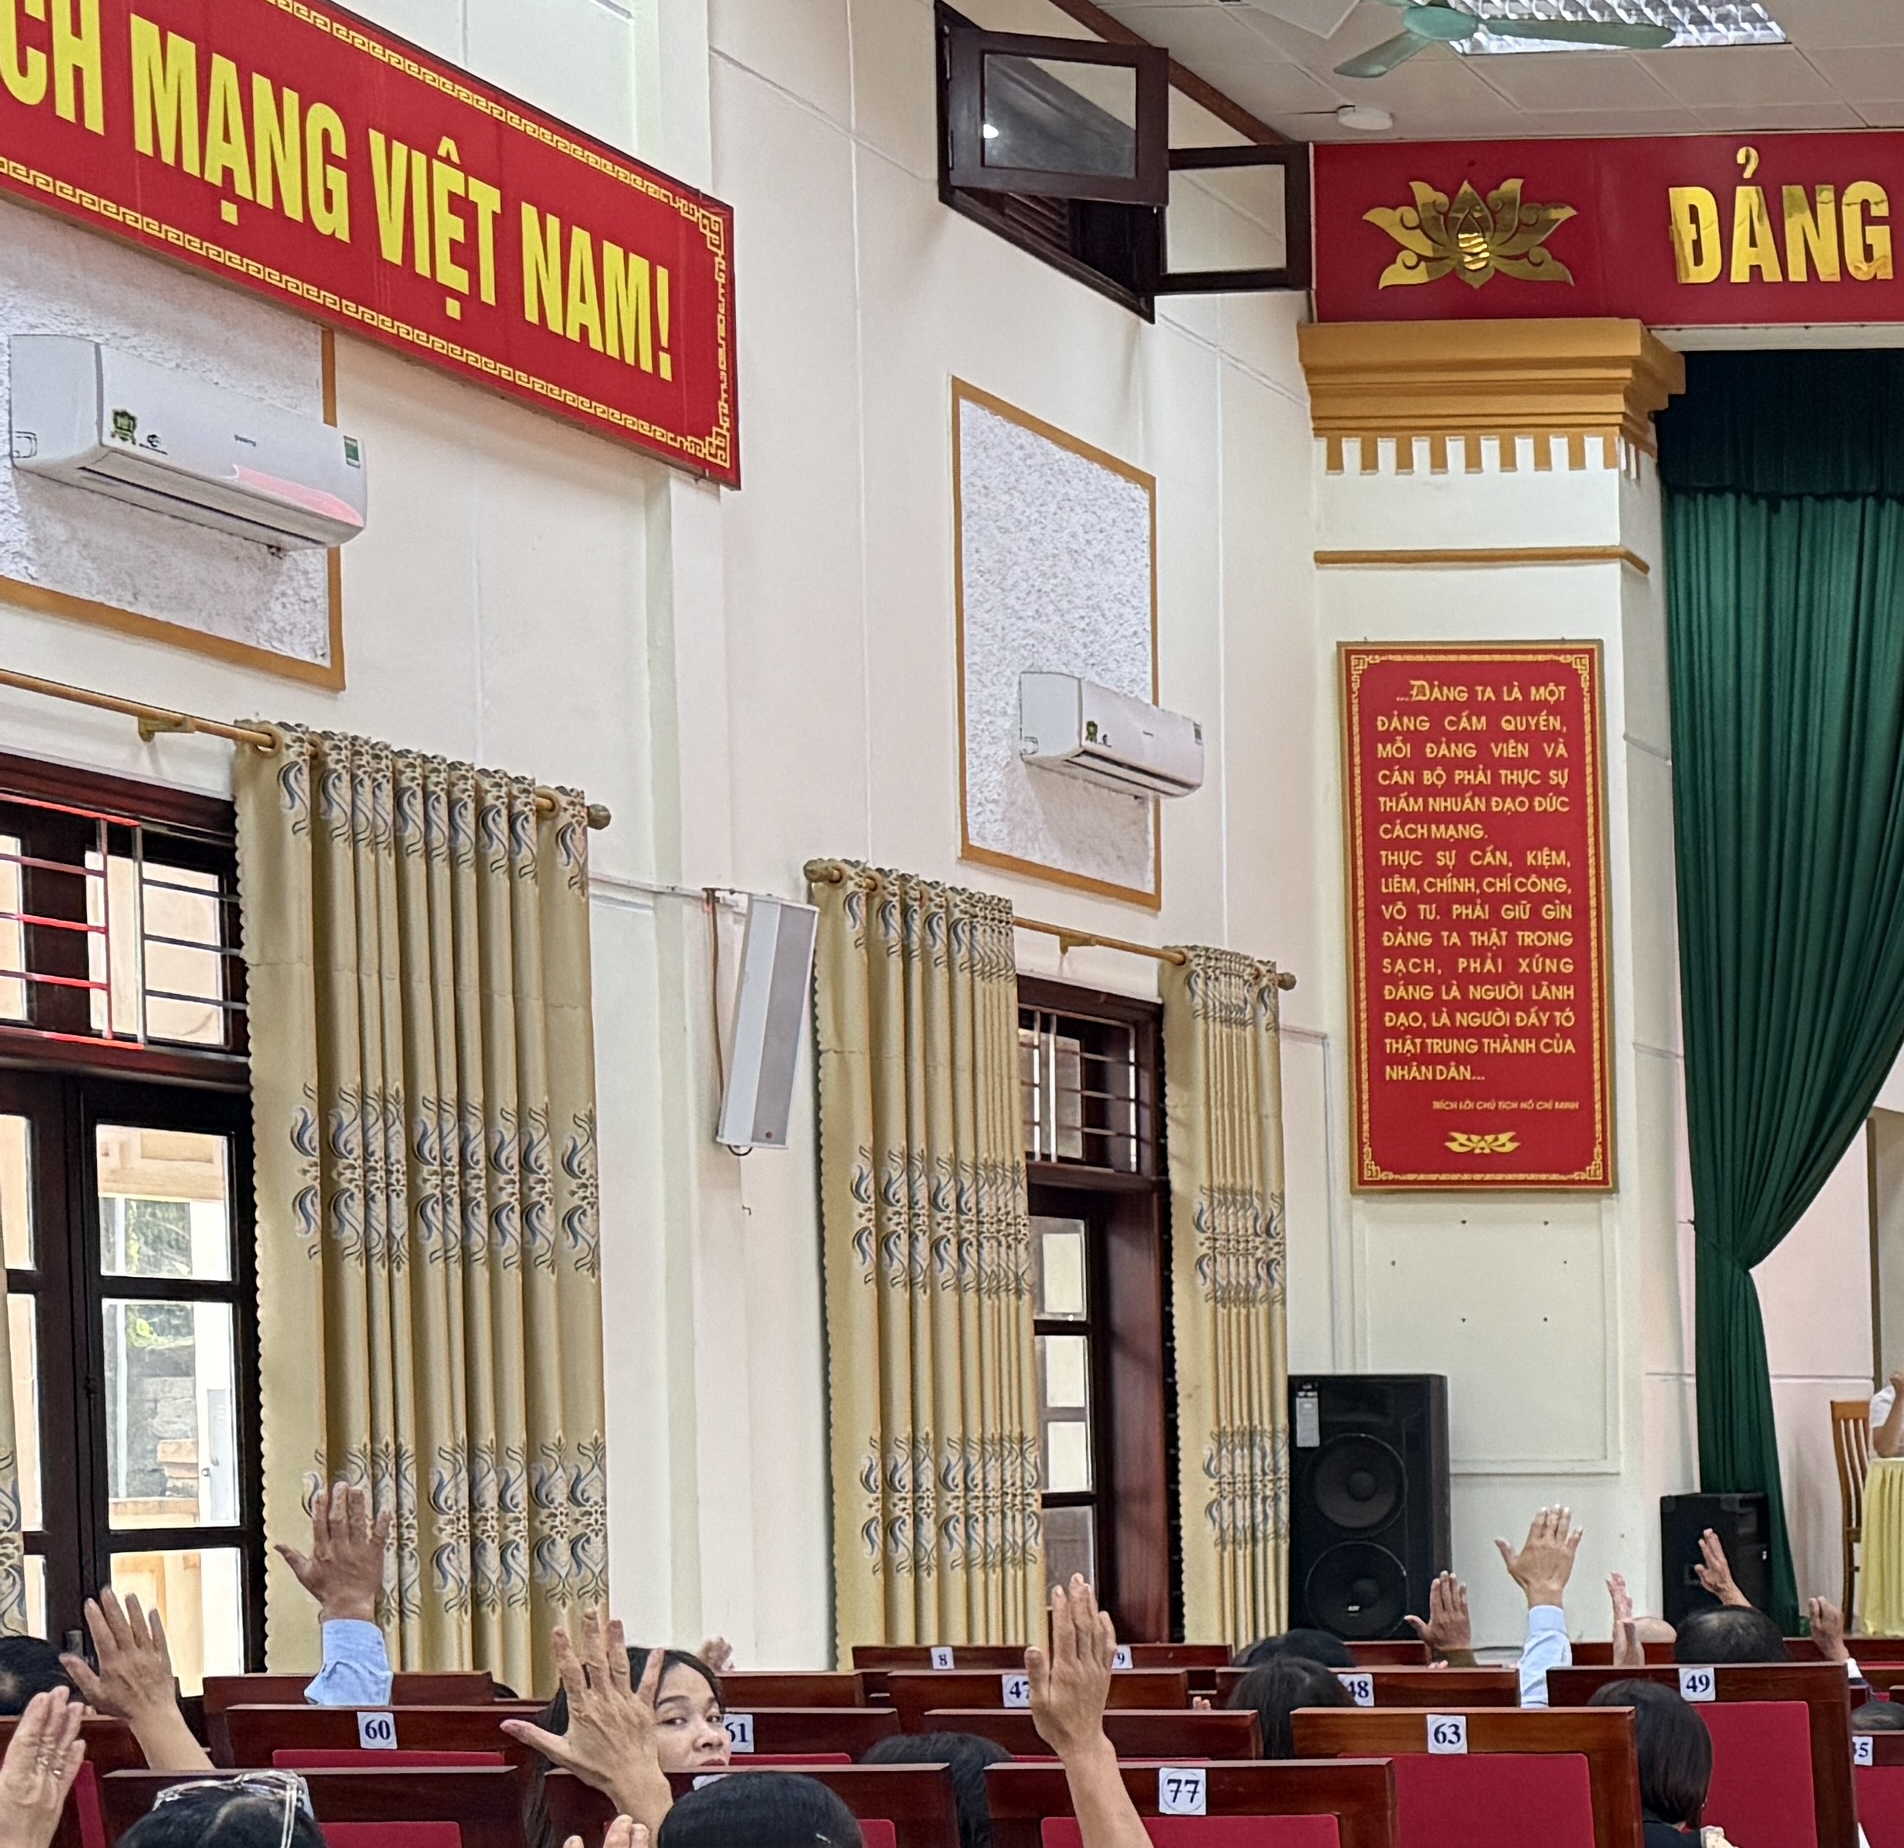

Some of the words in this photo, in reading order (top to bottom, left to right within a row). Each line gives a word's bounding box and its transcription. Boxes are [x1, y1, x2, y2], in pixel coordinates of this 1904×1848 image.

[125, 8, 356, 246] MẠNG
[369, 131, 501, 319] VIỆT
[522, 202, 672, 381] NAM!
[1670, 147, 1892, 283] ĐẢNG
[1474, 686, 1496, 701] TA
[1502, 681, 1523, 701] LÀ
[1530, 682, 1567, 704] MỘT
[1424, 737, 1478, 758] ĐẢNG
[1490, 739, 1529, 757] VIÊN
[1542, 738, 1569, 757] VÀ
[1377, 765, 1415, 785] CÁN
[1422, 766, 1447, 788] BỘ
[1454, 764, 1492, 785] PHẢI
[1498, 768, 1542, 788] THỰC
[1548, 768, 1569, 788] SỰ
[1379, 820, 1428, 839] CÁCH
[1430, 824, 1489, 842] MẠNG.
[1381, 900, 1407, 919] VÔ
[1452, 898, 1489, 919] PHẢI
[1500, 900, 1532, 919] GIỮ
[1541, 899, 1573, 919] GÌN
[1381, 926, 1433, 947] ĐẢNG
[1440, 931, 1462, 946] TA
[1469, 927, 1508, 950] THẬT
[1515, 931, 1574, 947] TRONG
[1441, 981, 1462, 1000] LÀ
[1468, 981, 1524, 1000] NGƯỜI
[1531, 981, 1575, 999] LÃNH
[1384, 1035, 1423, 1056] THẬT
[1424, 1039, 1479, 1053] TRUNG
[1481, 1034, 1536, 1053] THÀNH
[1539, 1033, 1576, 1053] CỦA
[1686, 1675, 1710, 1692] 49
[365, 1720, 390, 1739] 60
[1434, 1724, 1460, 1744] 63
[1167, 1779, 1199, 1803] 77
